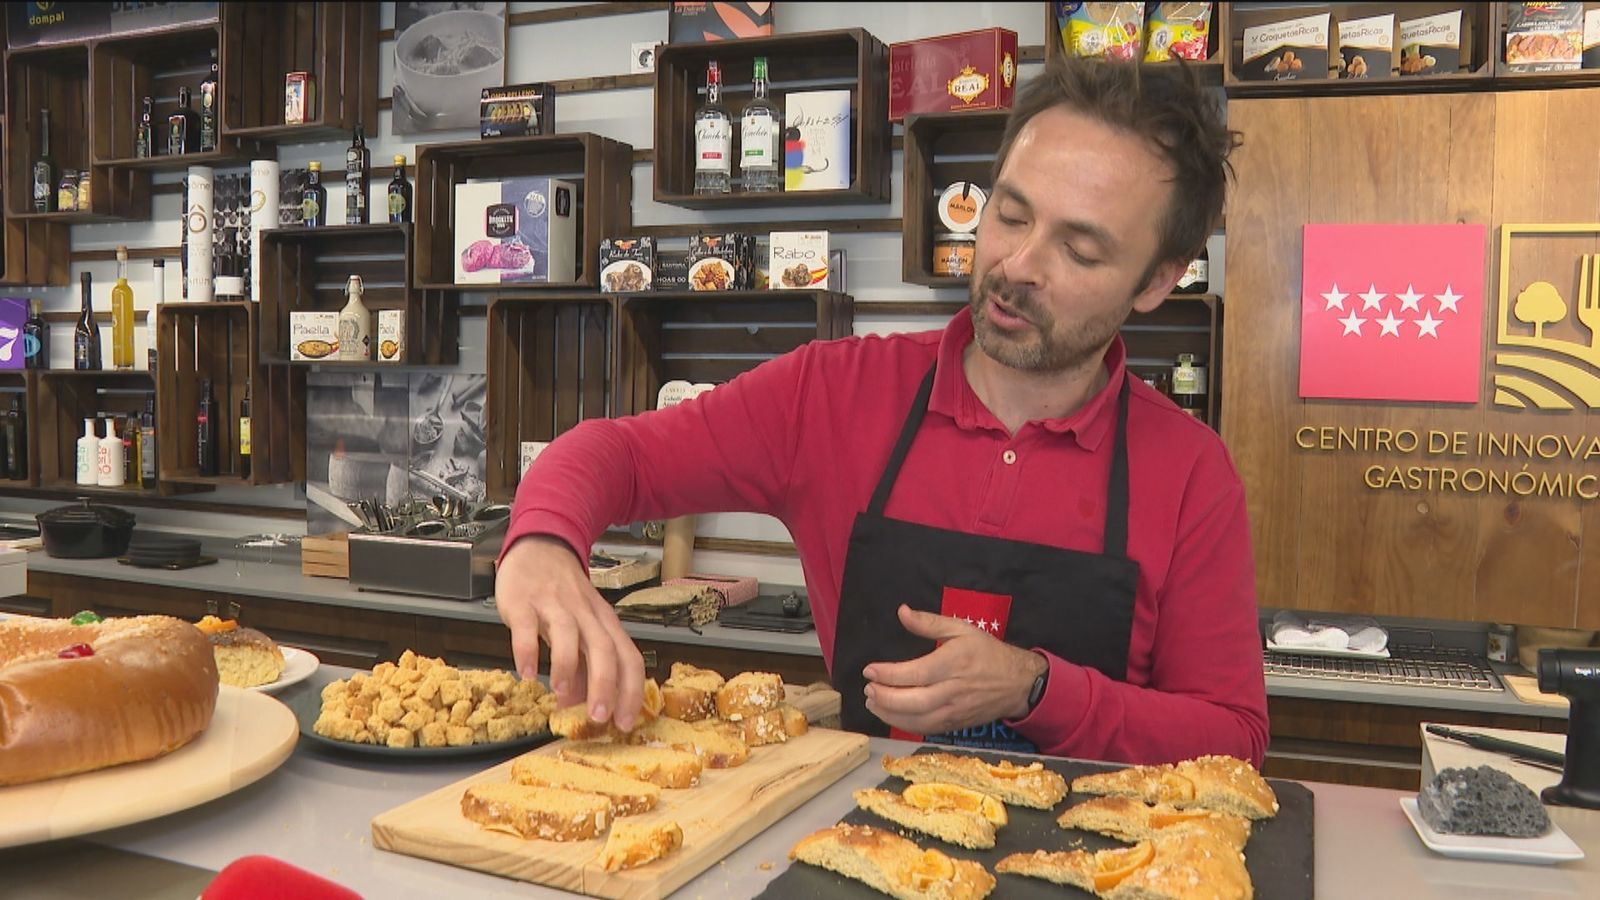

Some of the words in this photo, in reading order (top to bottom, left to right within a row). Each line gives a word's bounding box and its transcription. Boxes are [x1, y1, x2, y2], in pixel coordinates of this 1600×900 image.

[29, 11, 65, 26] dompal
[954, 83, 982, 93] REAL
[949, 203, 976, 214] MARLON
[773, 246, 816, 260] Rabo
[293, 323, 330, 335] Paella
[1295, 426, 1419, 453] CENTRO
[1427, 431, 1469, 455] DE
